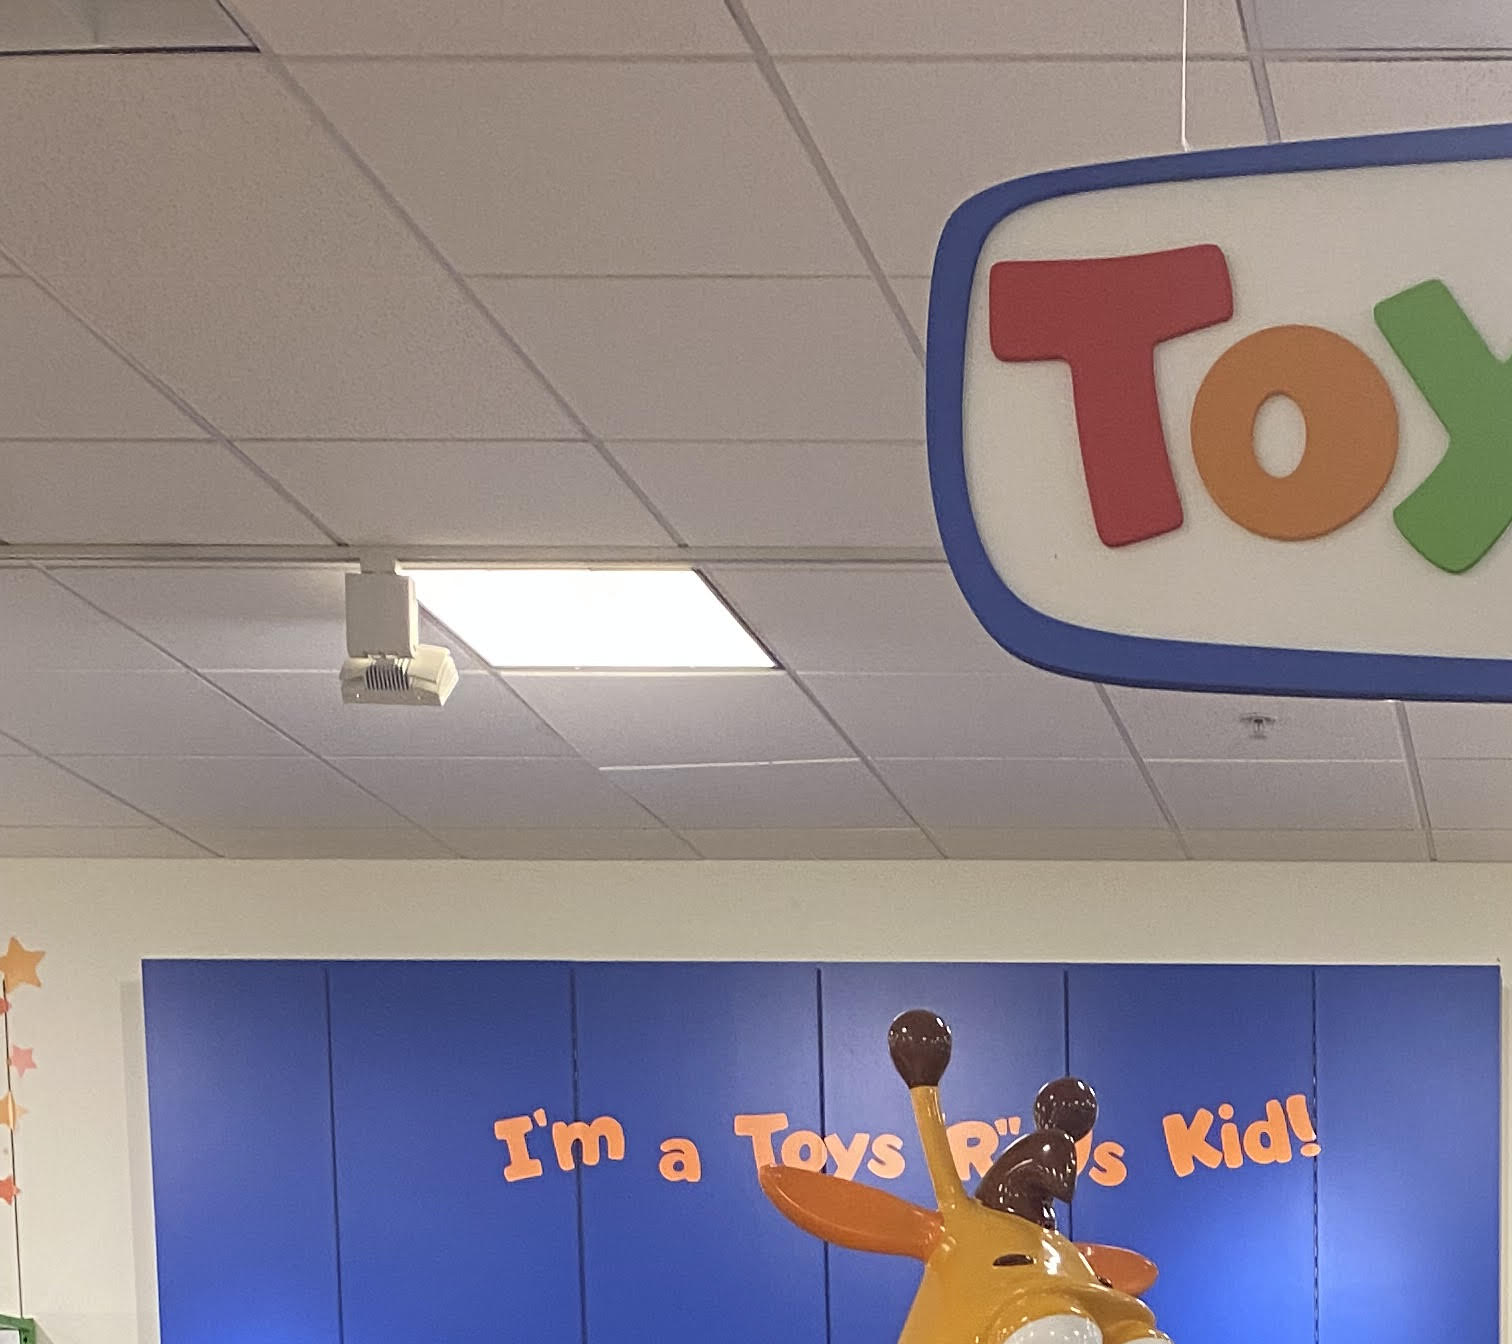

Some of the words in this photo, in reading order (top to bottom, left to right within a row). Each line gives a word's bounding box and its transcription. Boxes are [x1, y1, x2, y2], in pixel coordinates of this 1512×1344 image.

[494, 1109, 626, 1182] I'm
[659, 1138, 701, 1182] a
[734, 1113, 905, 1181] Toys
[1163, 1094, 1321, 1178] Kid!
